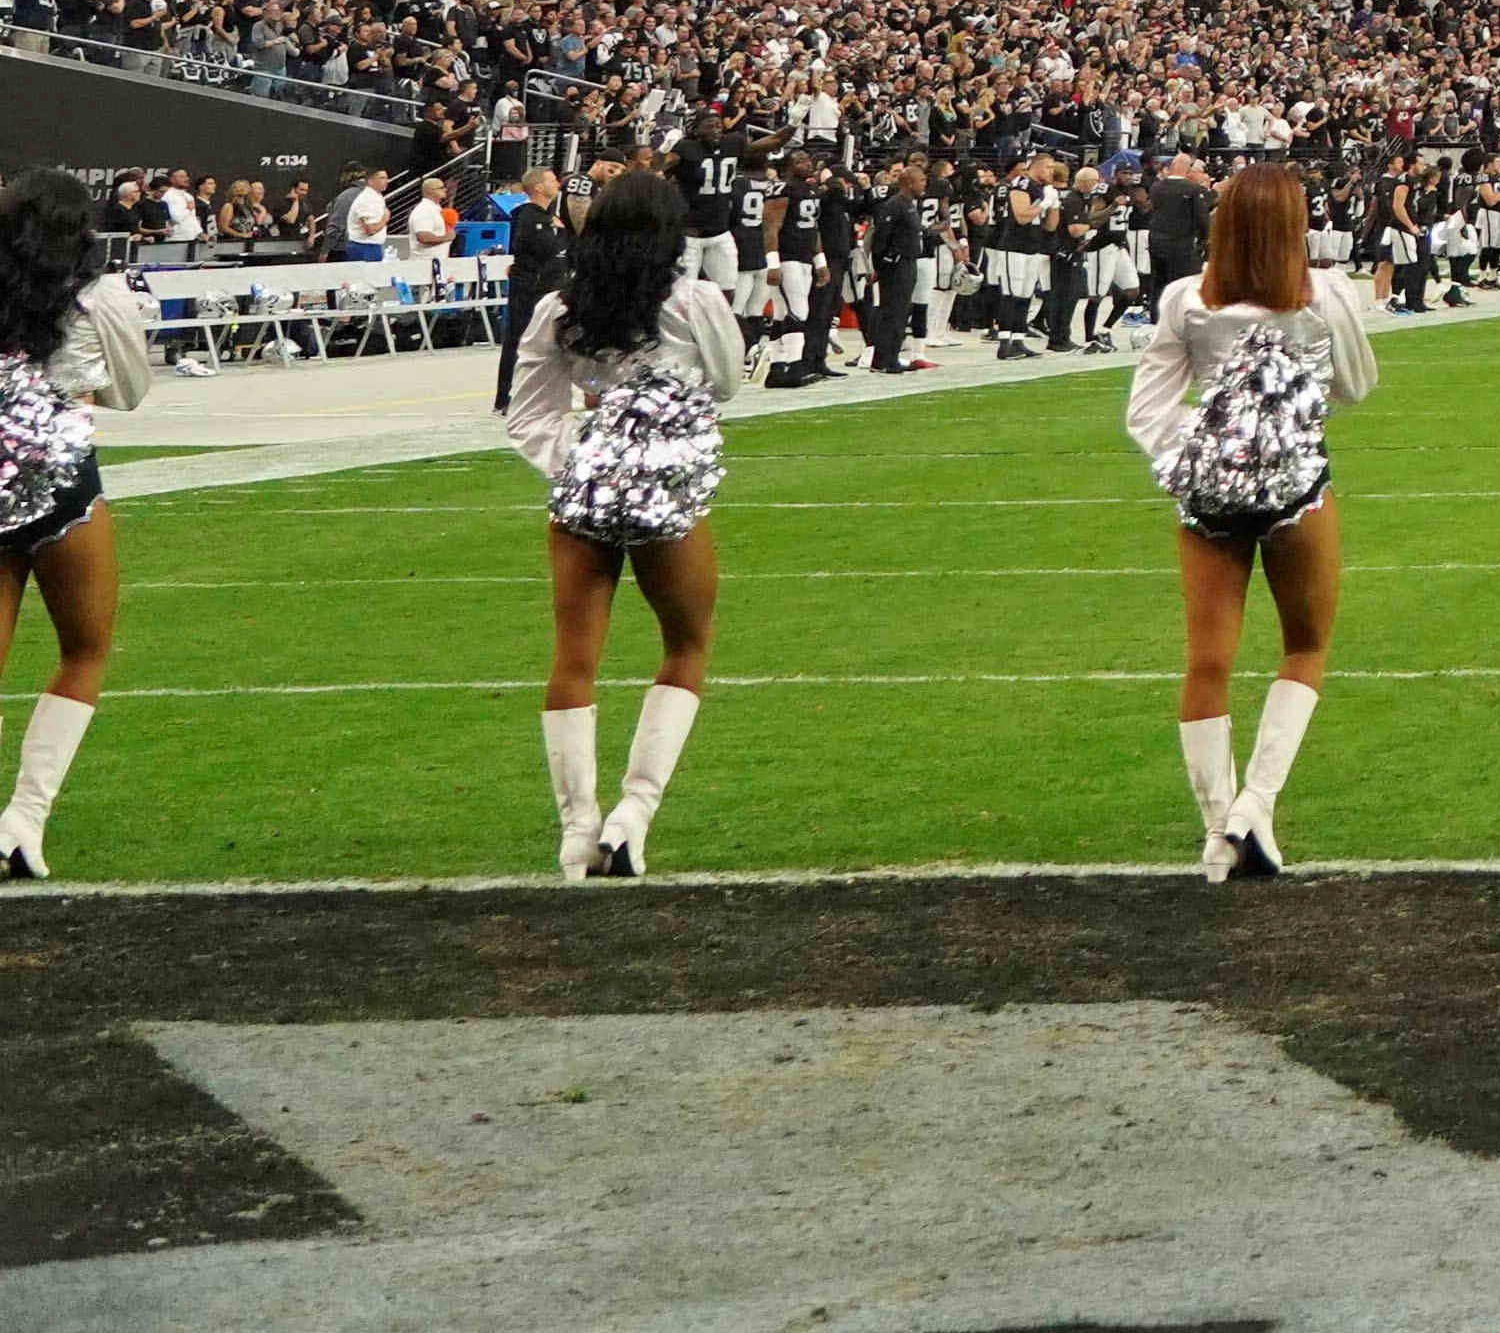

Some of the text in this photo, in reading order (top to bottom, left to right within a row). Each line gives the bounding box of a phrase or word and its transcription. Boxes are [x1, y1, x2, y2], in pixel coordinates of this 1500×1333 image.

[276, 155, 308, 166] C134
[700, 157, 738, 195] 10
[567, 178, 592, 195] 98
